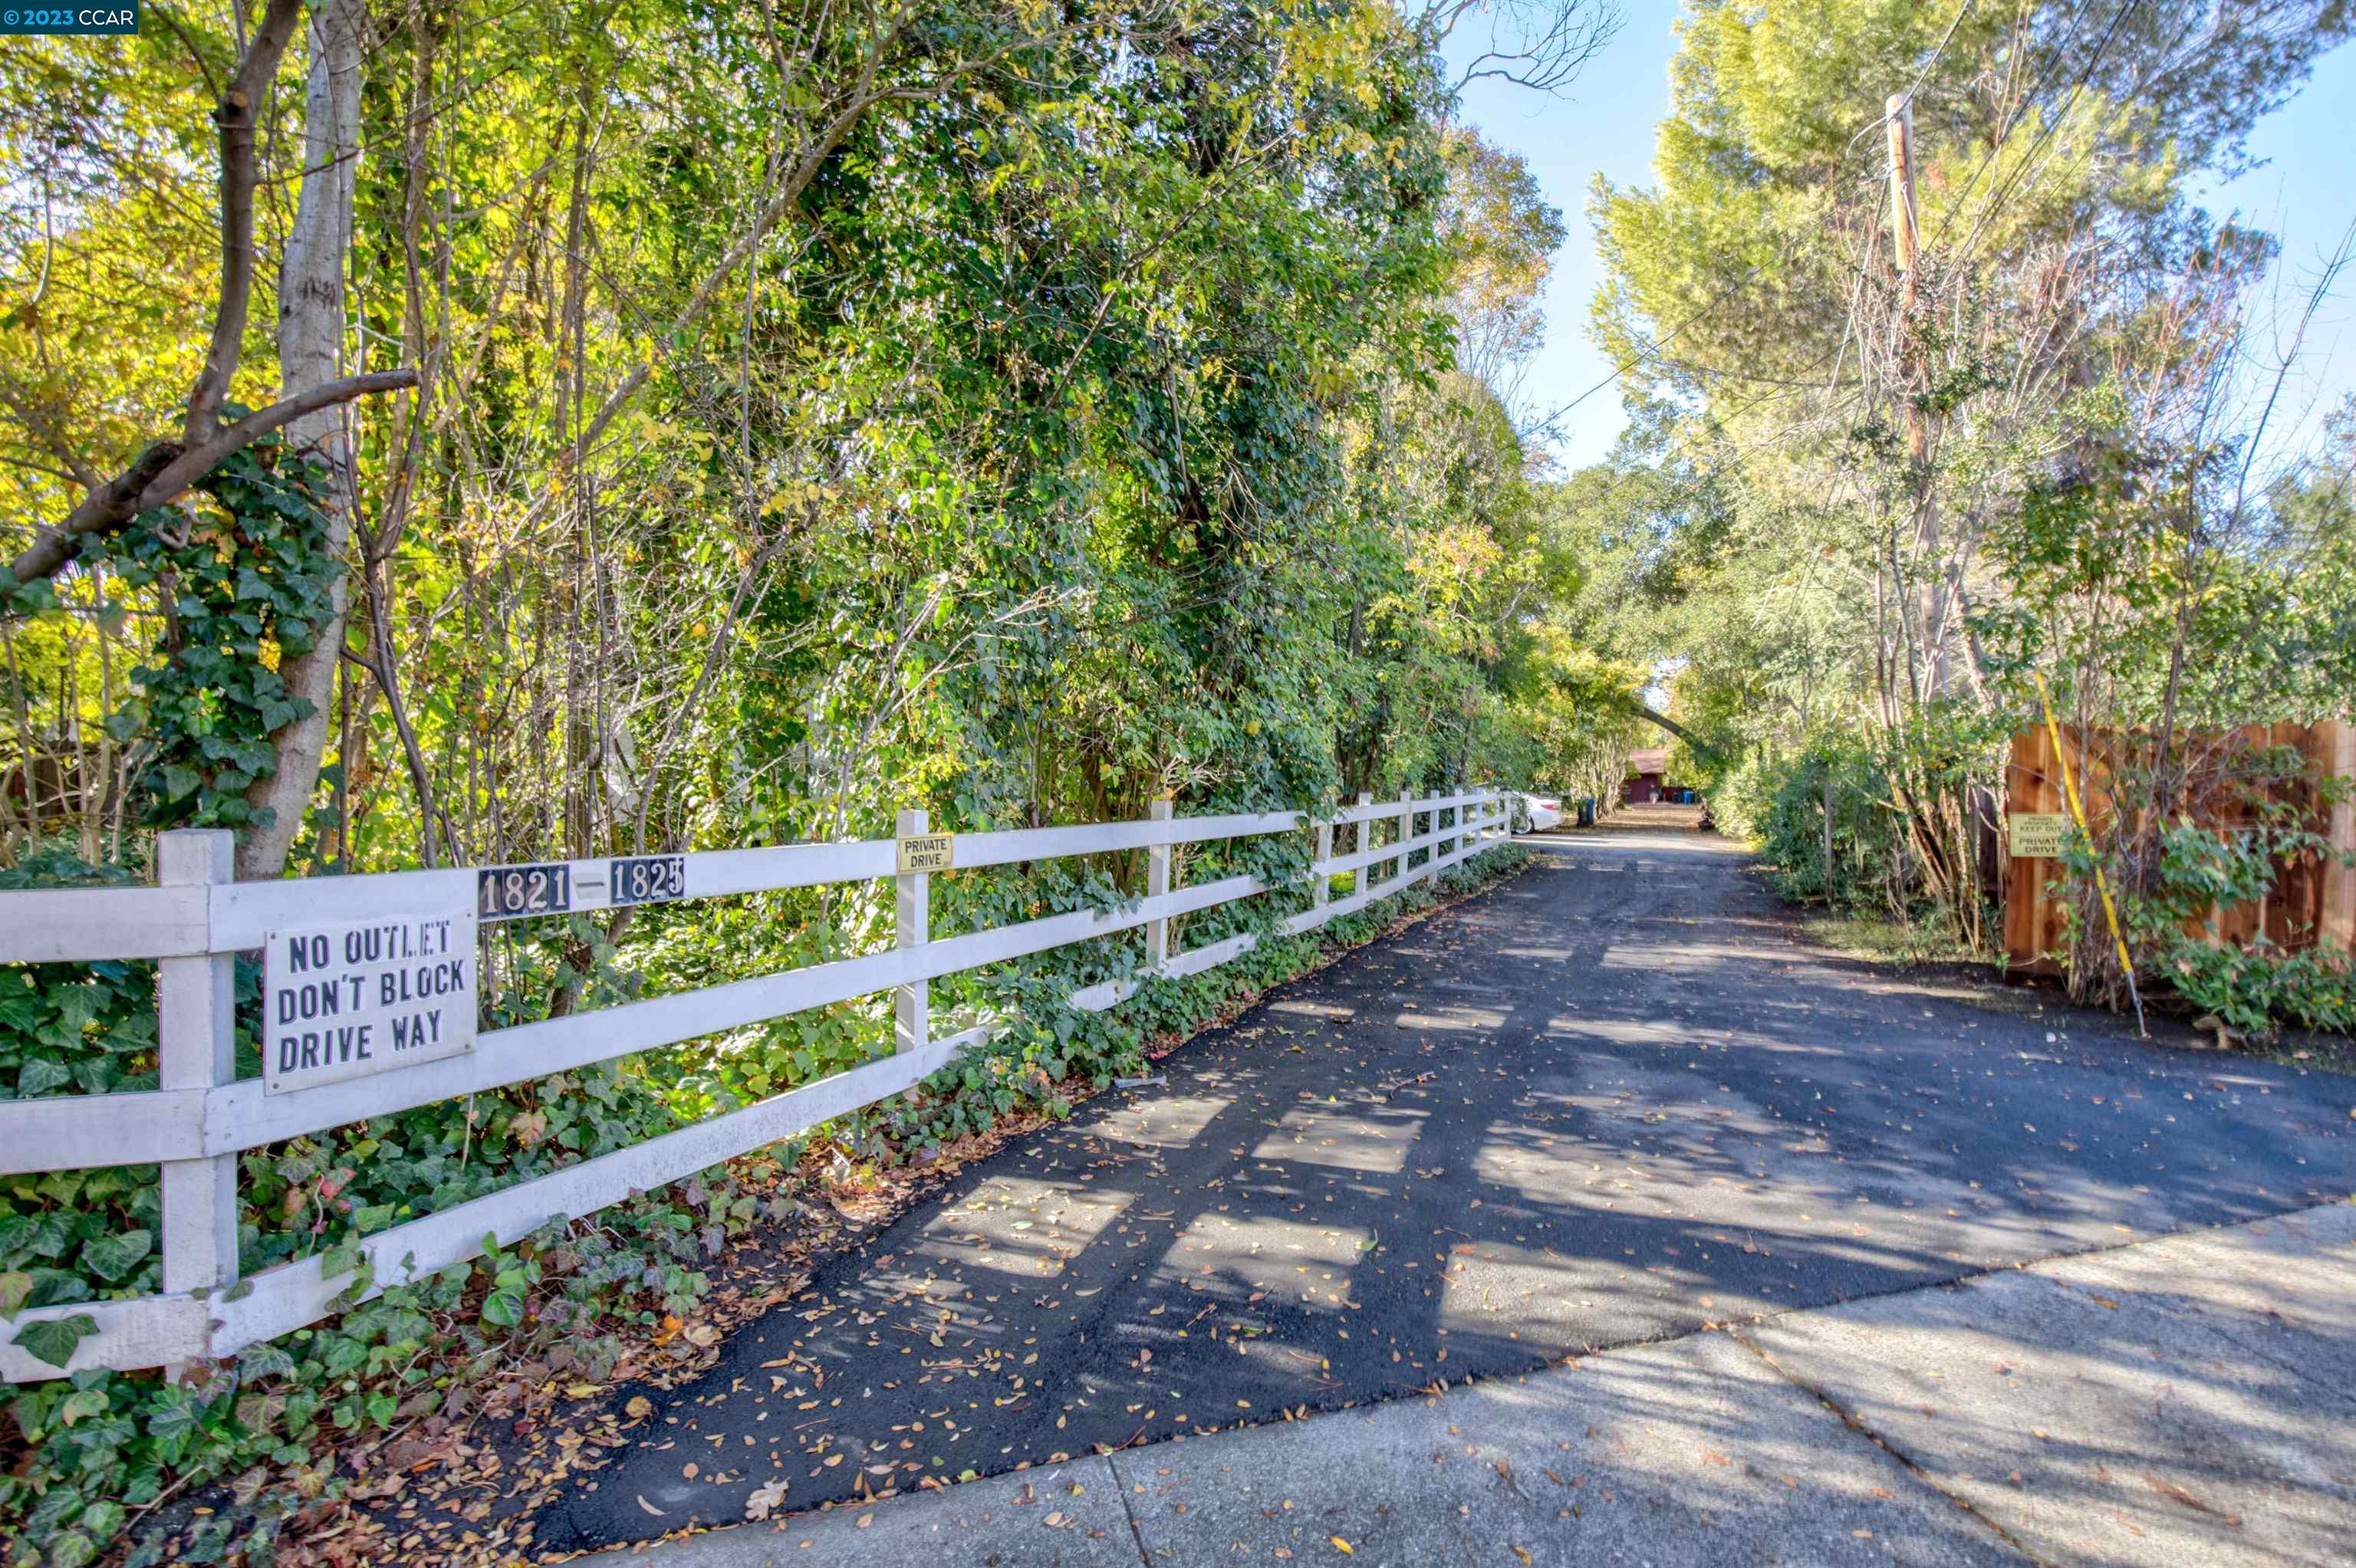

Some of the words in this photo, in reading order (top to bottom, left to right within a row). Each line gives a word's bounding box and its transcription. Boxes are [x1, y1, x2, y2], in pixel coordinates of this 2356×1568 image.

[905, 838, 947, 853] PRIVATE
[910, 853, 942, 868] DRIVE
[483, 869, 567, 913] 1821
[614, 858, 683, 899] 1825
[288, 933, 331, 975] NO
[344, 919, 452, 965] OUTLET
[278, 974, 366, 1027] DON'T
[380, 959, 466, 1008] BLOCK
[279, 1024, 373, 1074] DRIVE
[391, 1009, 443, 1052] WAY
